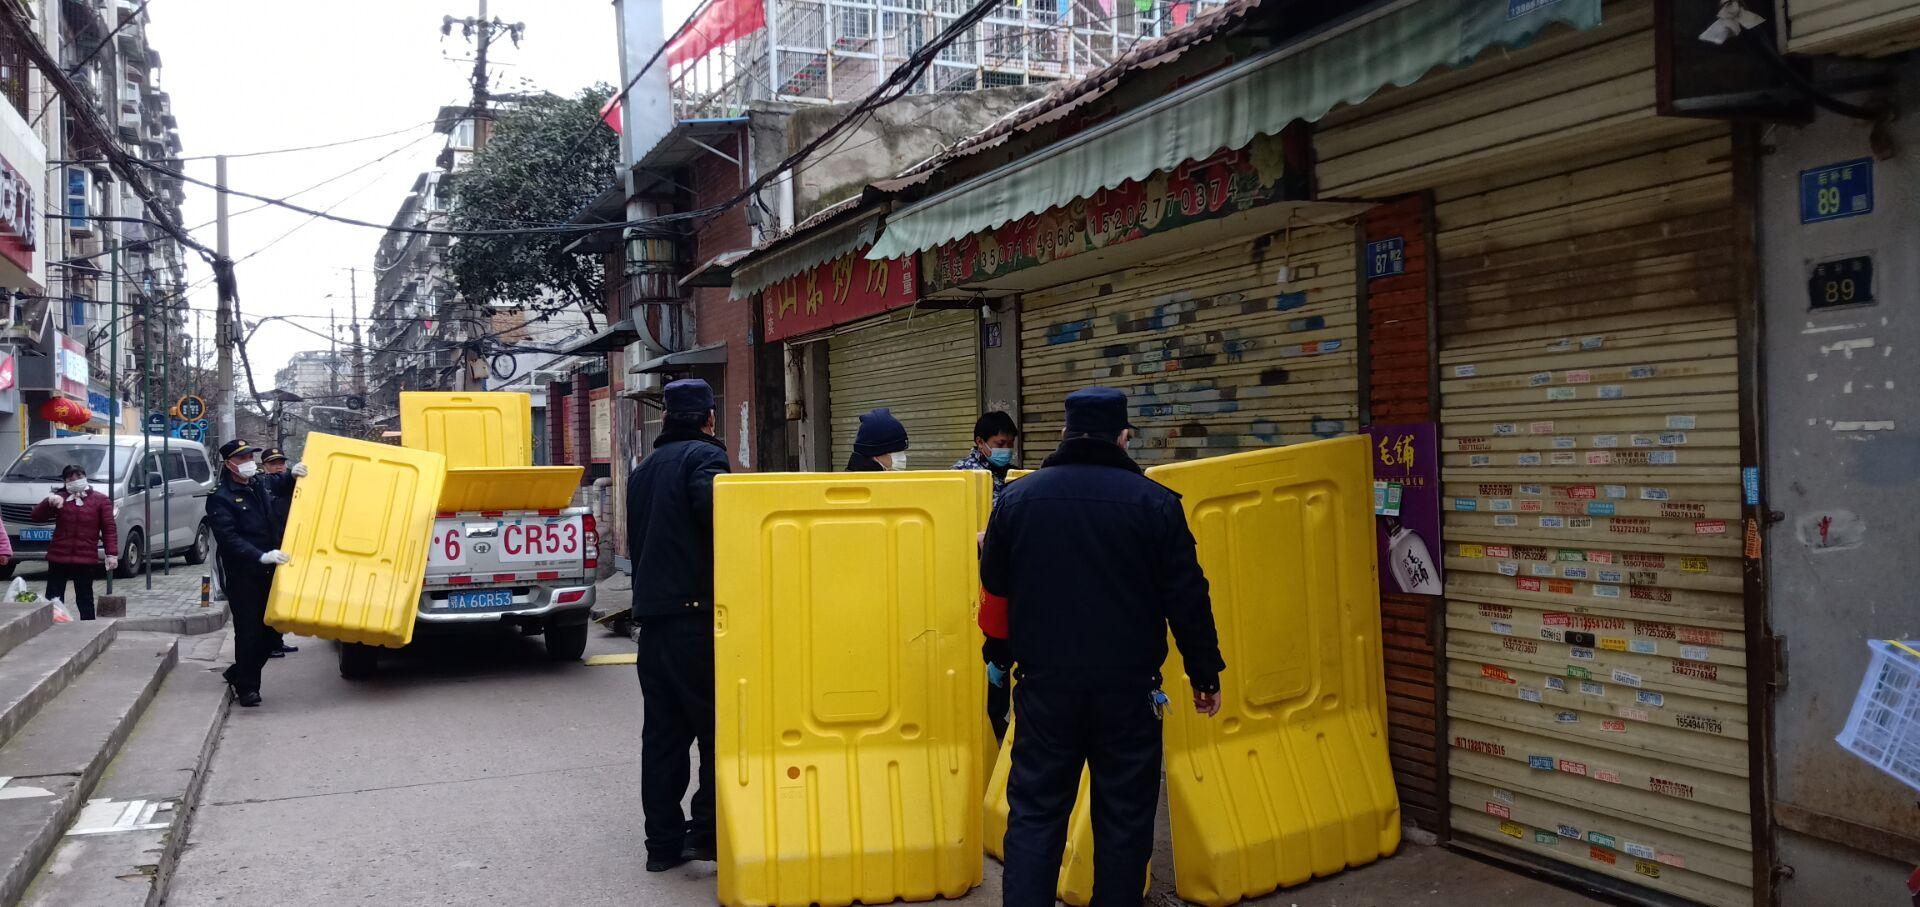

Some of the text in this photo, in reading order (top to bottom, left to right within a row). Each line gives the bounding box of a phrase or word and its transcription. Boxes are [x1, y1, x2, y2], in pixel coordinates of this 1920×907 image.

[1090, 173, 1238, 236] 15202770374
[1817, 187, 1840, 214] 89
[1376, 254, 1387, 274] 87
[1825, 278, 1855, 302] 89
[1378, 433, 1415, 475] 毛铺
[504, 524, 577, 556] CR53
